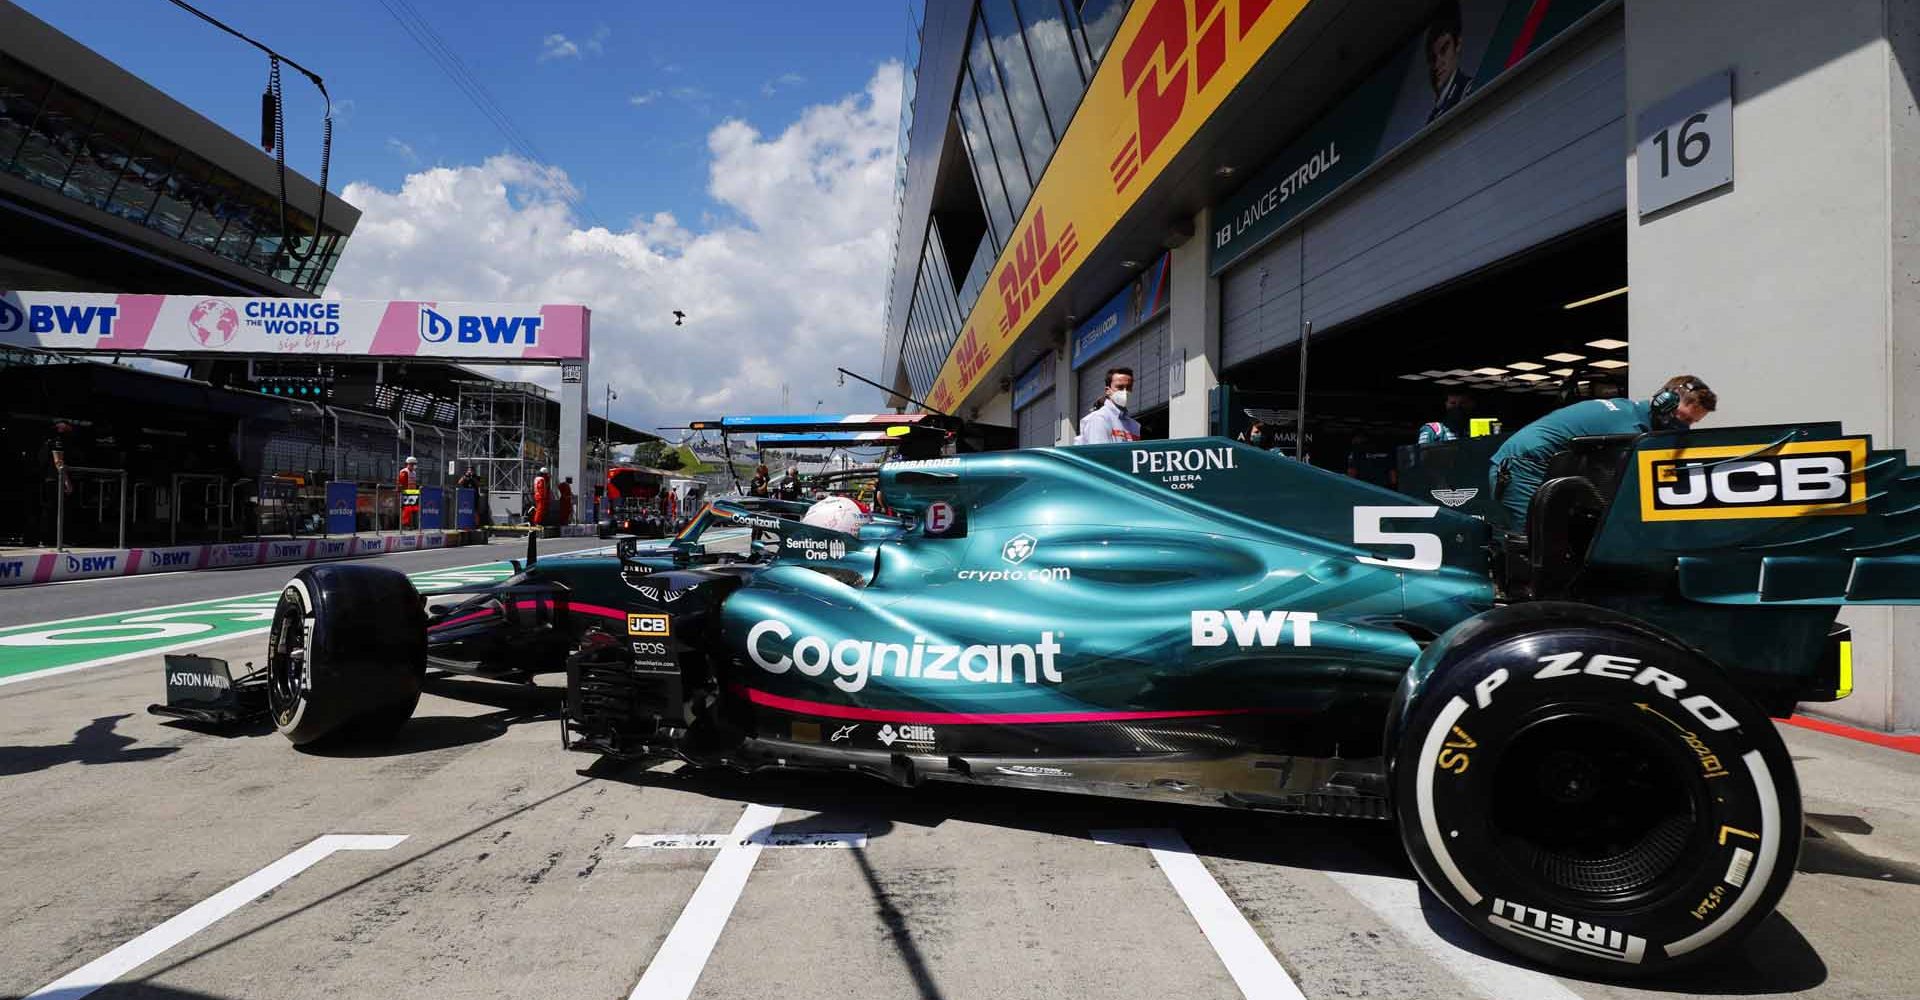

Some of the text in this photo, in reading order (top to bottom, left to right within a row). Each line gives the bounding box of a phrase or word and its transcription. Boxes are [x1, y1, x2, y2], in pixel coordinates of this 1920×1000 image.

[1652, 112, 1711, 179] 16
[1216, 141, 1340, 249] 18 LANCE STROLL
[999, 206, 1061, 330] DHL
[29, 305, 116, 335] BWT
[245, 302, 340, 320] CHANGE
[264, 320, 339, 335] WORLD
[458, 316, 541, 344] BWT
[280, 338, 298, 351] sip
[956, 326, 986, 389] DHL
[1274, 433, 1312, 441] MARN
[883, 458, 960, 470] BOMBARDIER
[1132, 447, 1233, 473] PERONI
[1657, 456, 1847, 505] JCB
[731, 514, 780, 529] Cognizant
[931, 505, 945, 529] E
[786, 538, 828, 550] Sentinel
[1353, 505, 1442, 571] 5
[162, 551, 191, 566] BWT
[806, 549, 828, 560] One
[0, 561, 23, 578] WT
[82, 556, 116, 573] BWT
[957, 566, 1071, 582] crypto.com
[631, 618, 666, 632] JCB
[1191, 610, 1318, 647] BWT
[632, 642, 666, 655] EPOS
[746, 619, 1063, 693] Cognizant
[170, 672, 231, 690] ASTON MARTIN
[1474, 651, 1741, 732] P ZERO
[899, 725, 935, 740] Cillit
[1487, 898, 1647, 965] PIRELLI
